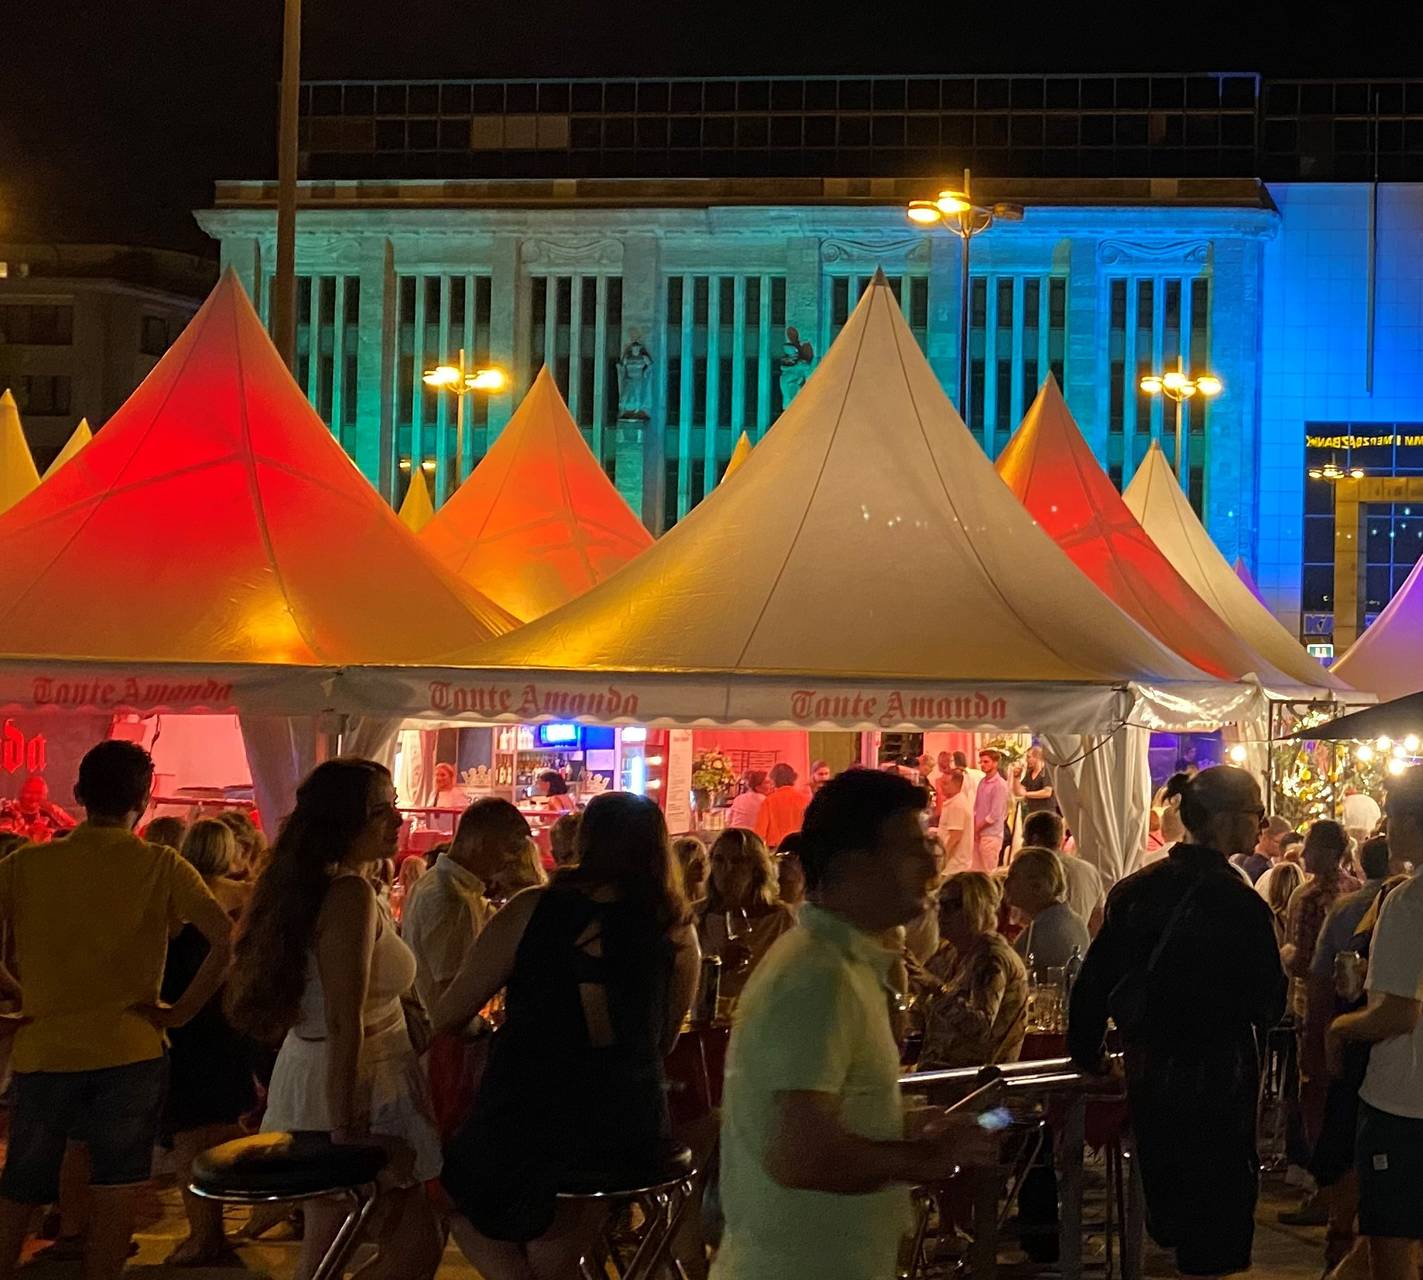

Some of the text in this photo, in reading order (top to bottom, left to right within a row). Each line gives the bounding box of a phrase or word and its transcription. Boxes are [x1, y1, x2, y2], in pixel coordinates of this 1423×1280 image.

[33, 677, 233, 704] Tante Amanda
[428, 680, 640, 715] Tante Amanda
[791, 690, 1008, 727] Tante Amanda
[0, 717, 47, 774] da
